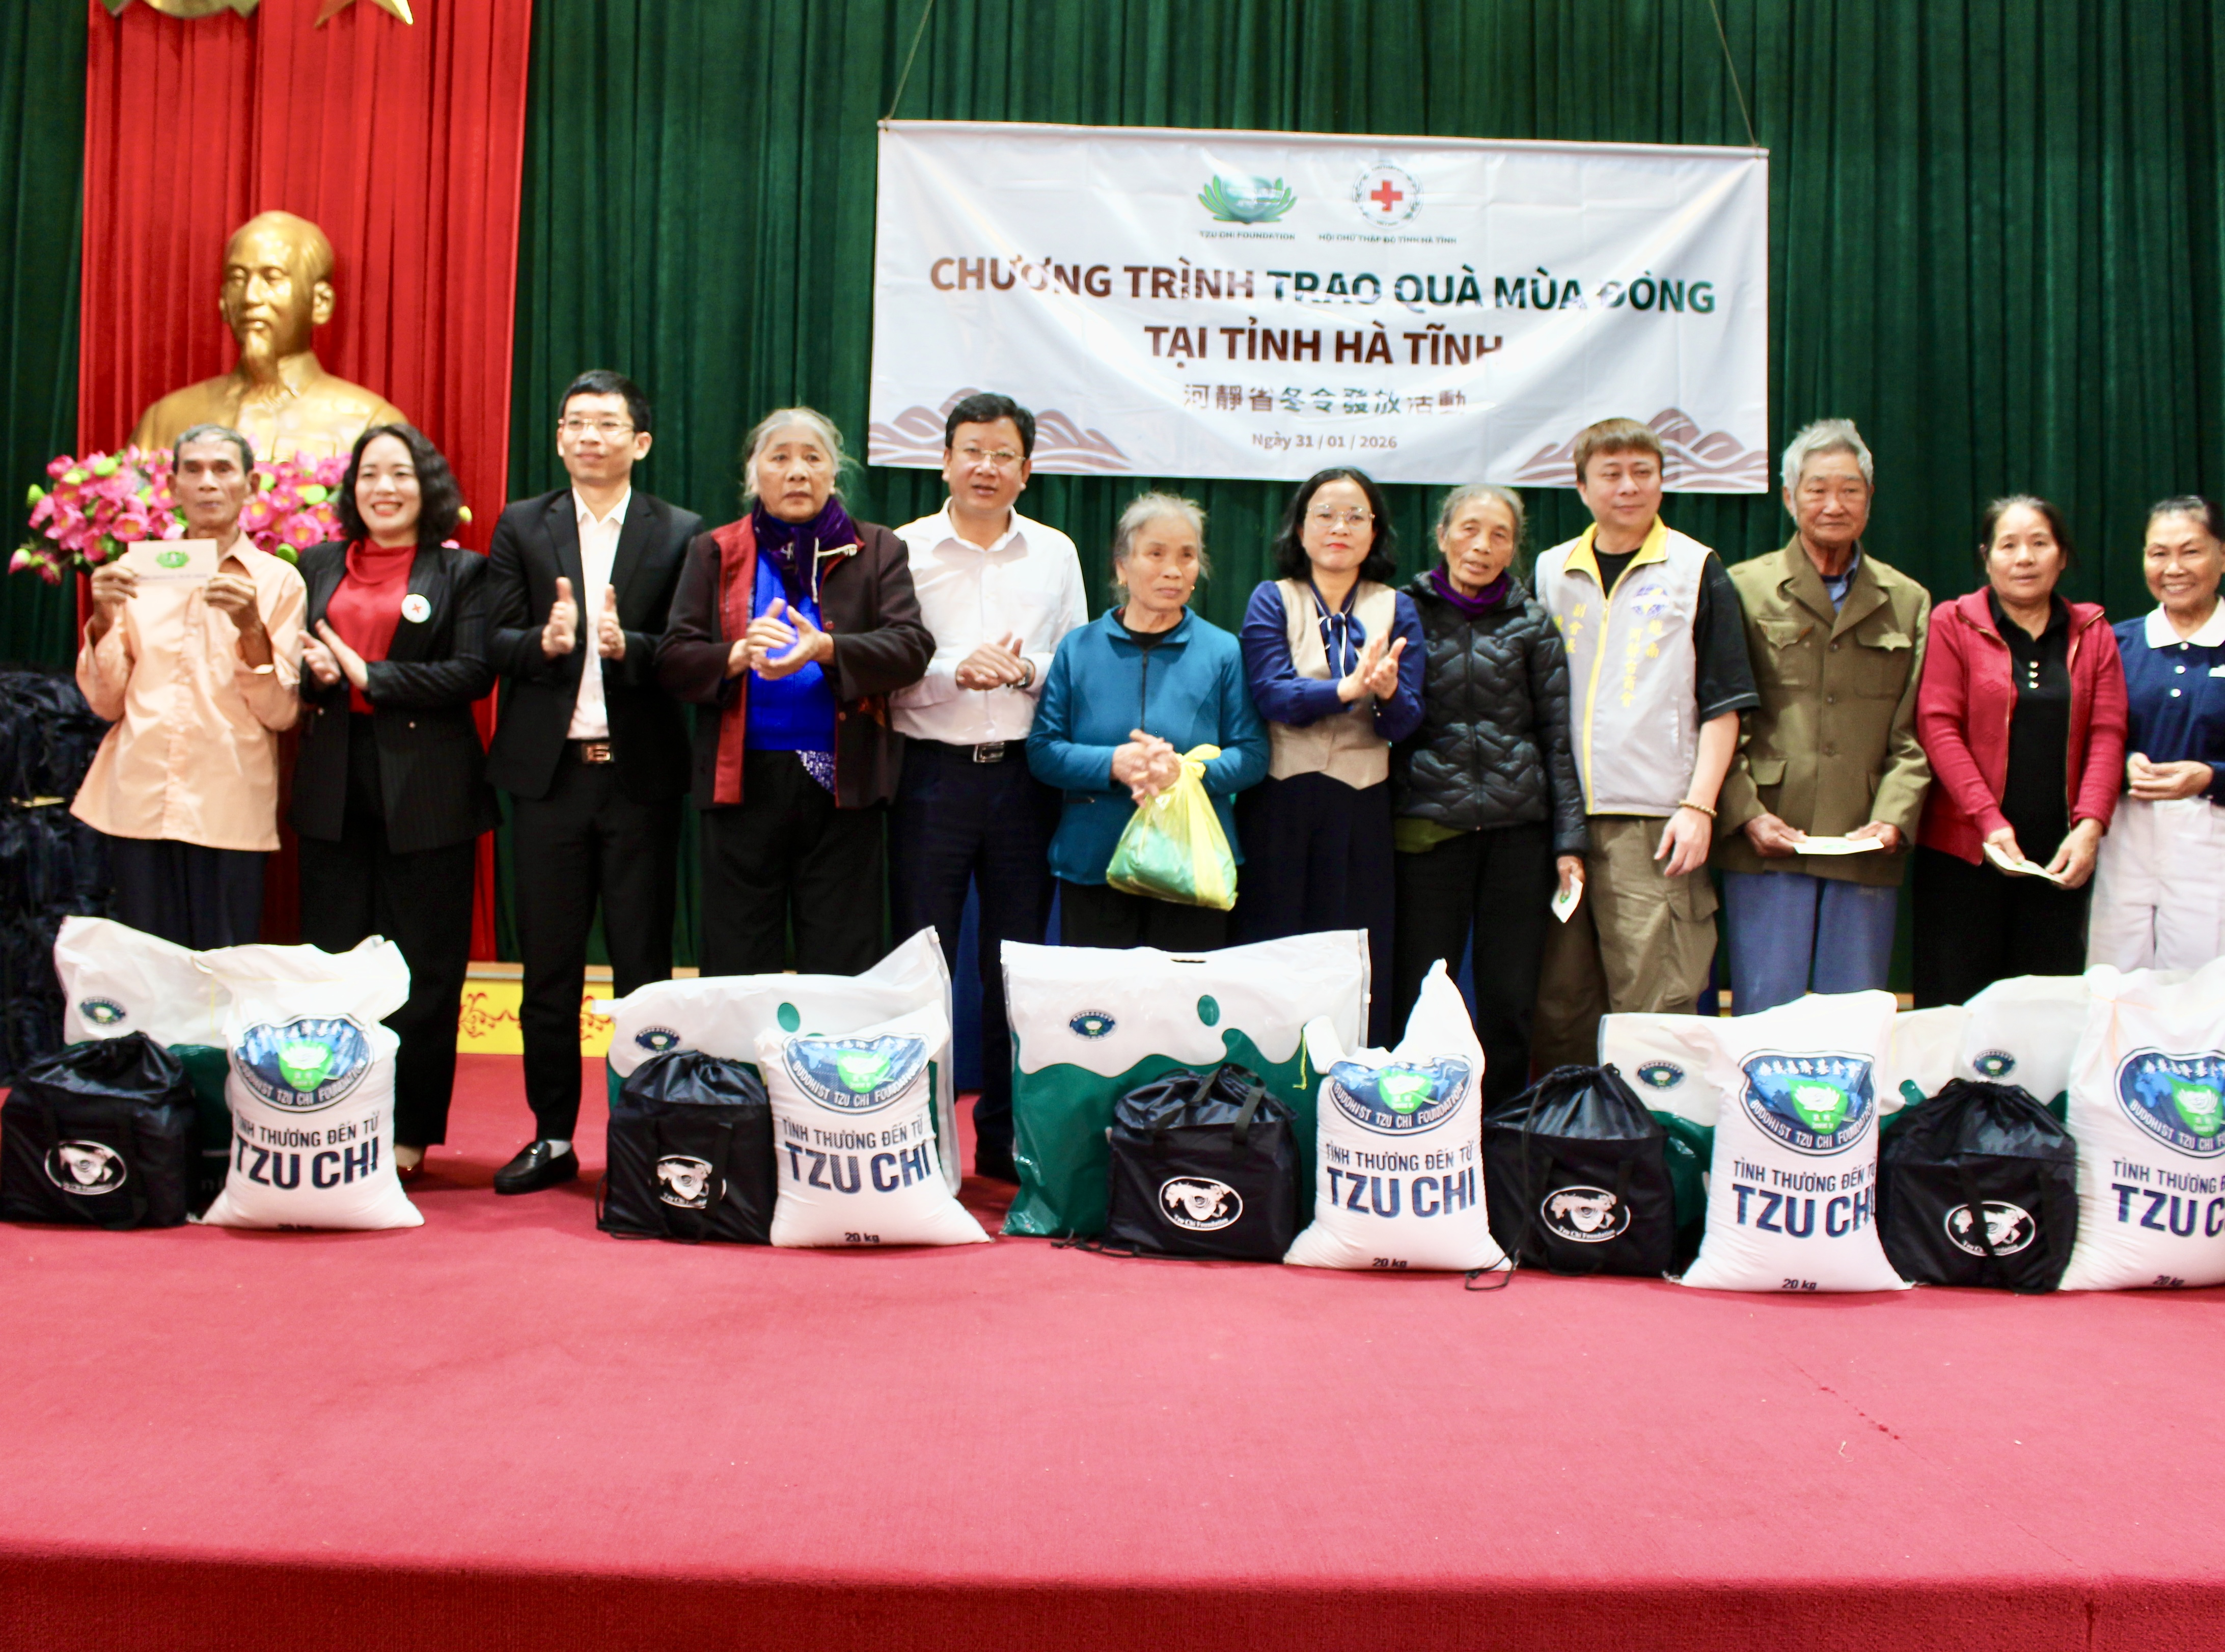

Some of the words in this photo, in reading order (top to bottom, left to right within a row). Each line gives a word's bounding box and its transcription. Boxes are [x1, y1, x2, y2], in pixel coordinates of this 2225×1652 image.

[1237, 231, 1296, 239] FOUNDATION
[930, 255, 1112, 297] CHƯƠNG
[1123, 256, 1254, 300] TRÌNH
[1267, 270, 1382, 305] TRAO
[1394, 264, 1483, 314] QUÀ
[1495, 267, 1588, 310] MÙA
[1144, 325, 1207, 368] TẠI
[1220, 316, 1321, 363] TỈNH
[1335, 320, 1393, 365] HÀ
[1404, 323, 1503, 366] TĨNH
[1184, 384, 1467, 416] 河靜省冬令發放活動
[1252, 431, 1292, 451] Ngày
[1296, 434, 1314, 448] 31
[1327, 434, 1345, 449] 01
[1360, 434, 1397, 450] 2026
[277, 1089, 294, 1105] TZU
[296, 1091, 314, 1106] CHI
[792, 1059, 831, 1100] BUDDHIST
[834, 1091, 850, 1107] TZU
[854, 1094, 870, 1107] CHI
[1334, 1082, 1373, 1122] BUDDHIST
[1376, 1113, 1393, 1128] TZU
[1396, 1115, 1413, 1128] CHI
[1418, 1082, 1465, 1125] FOUNDATION
[1750, 1099, 1792, 1139] BUDDHIST
[1796, 1131, 1814, 1148] TZU
[1817, 1135, 1833, 1148] CHI
[260, 1126, 321, 1147] THƯƠNG
[327, 1121, 356, 1145] ĐẾN
[783, 1116, 809, 1142] TÌNH
[814, 1129, 877, 1150] THƯƠNG
[882, 1122, 908, 1146] ĐẾN
[2129, 1098, 2175, 1141] BUDDHIST
[2178, 1132, 2196, 1150] TZU
[2199, 1137, 2214, 1151] CHI
[236, 1132, 300, 1190] TZU
[312, 1136, 379, 1189] CHI
[785, 1141, 862, 1195] TZU
[871, 1139, 932, 1193] CHI
[1326, 1140, 1350, 1165] TÌNH
[1355, 1151, 1419, 1171] THƯƠNG
[1425, 1148, 1454, 1170] ĐẾN
[1460, 1140, 1474, 1164] TỪ
[1327, 1166, 1400, 1219] TZU
[1412, 1166, 1476, 1218] CHI
[1734, 1157, 1766, 1182] TÌNH
[1772, 1169, 1836, 1193] THƯƠNG
[1842, 1165, 1865, 1190] ĐẾN
[2113, 1157, 2150, 1182] TÌNH
[2157, 1169, 2217, 1194] THƯƠNG
[1733, 1183, 1816, 1239] TZU
[2111, 1183, 2198, 1237] TZU
[845, 1232, 861, 1243] 20
[864, 1233, 881, 1244] kg
[1372, 1257, 1389, 1268] 20
[1391, 1259, 1407, 1269] kg
[1782, 1279, 1799, 1289] 20
[1801, 1280, 1817, 1291] kg
